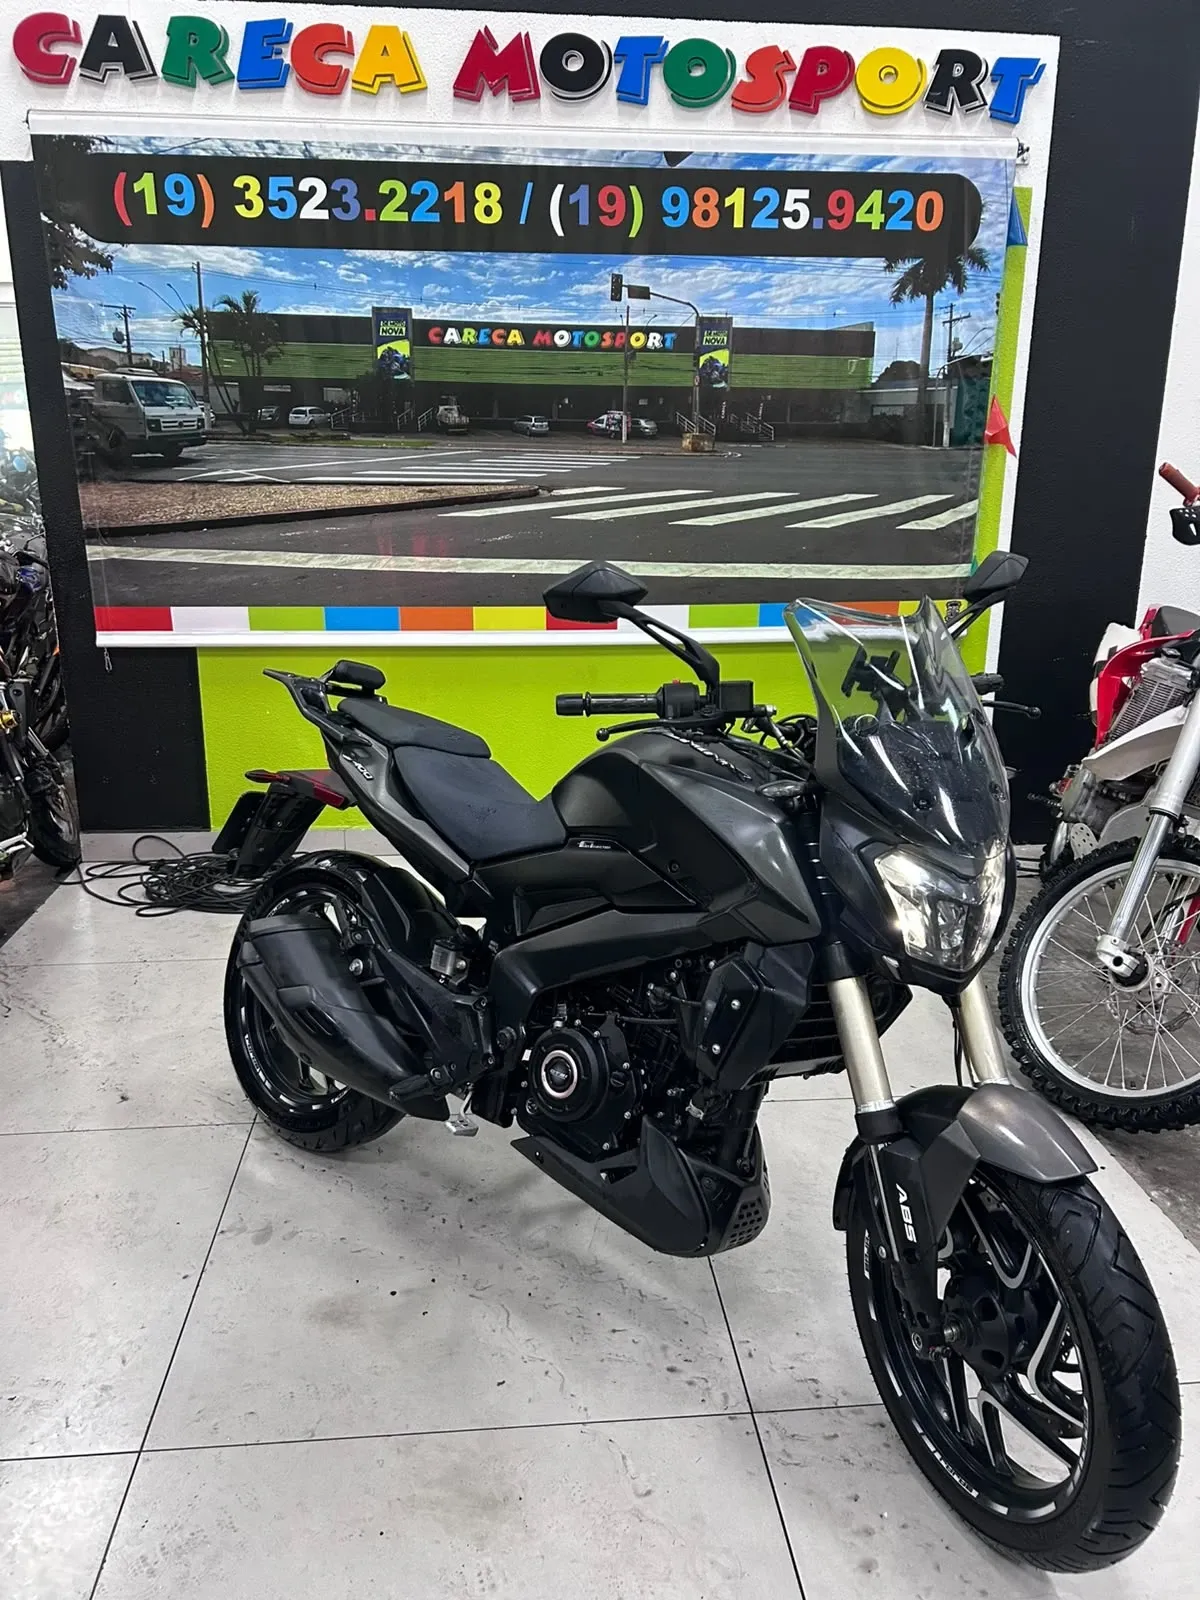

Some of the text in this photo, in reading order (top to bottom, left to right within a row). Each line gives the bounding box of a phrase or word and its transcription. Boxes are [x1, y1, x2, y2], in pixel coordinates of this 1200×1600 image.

[13, 13, 1046, 124] CARECA MOTOSPORT
[113, 171, 215, 228] (19)
[233, 174, 502, 223] 3523.2218
[549, 183, 644, 238] (19)
[661, 185, 944, 232] 98125.9420
[428, 326, 677, 350] CARECA MOTOSPORT
[895, 1182, 917, 1243] ABS
